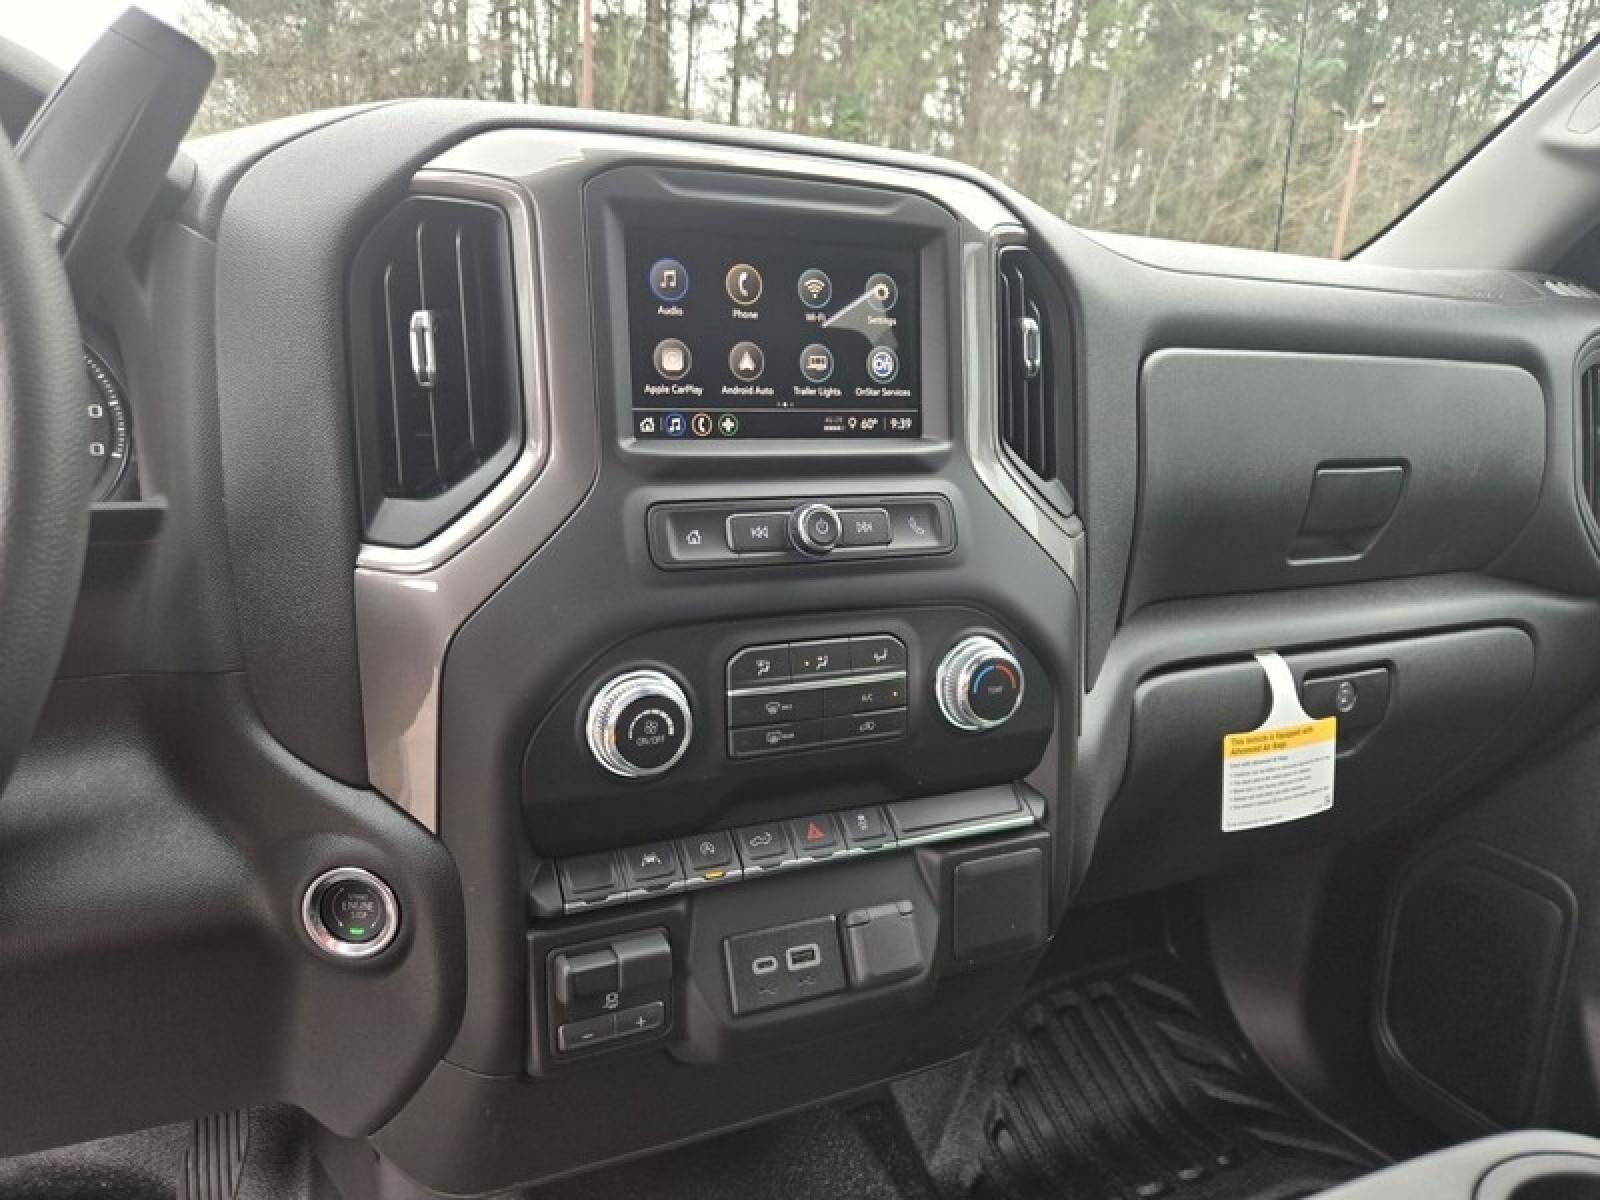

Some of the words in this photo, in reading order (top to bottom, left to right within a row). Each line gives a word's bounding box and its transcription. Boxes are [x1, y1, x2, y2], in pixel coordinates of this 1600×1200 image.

[657, 305, 683, 316] Audio
[732, 307, 759, 319] Phone
[643, 384, 670, 397] Apple
[671, 384, 704, 397] CarPlay
[721, 386, 754, 396] Android
[755, 387, 775, 397] Auto
